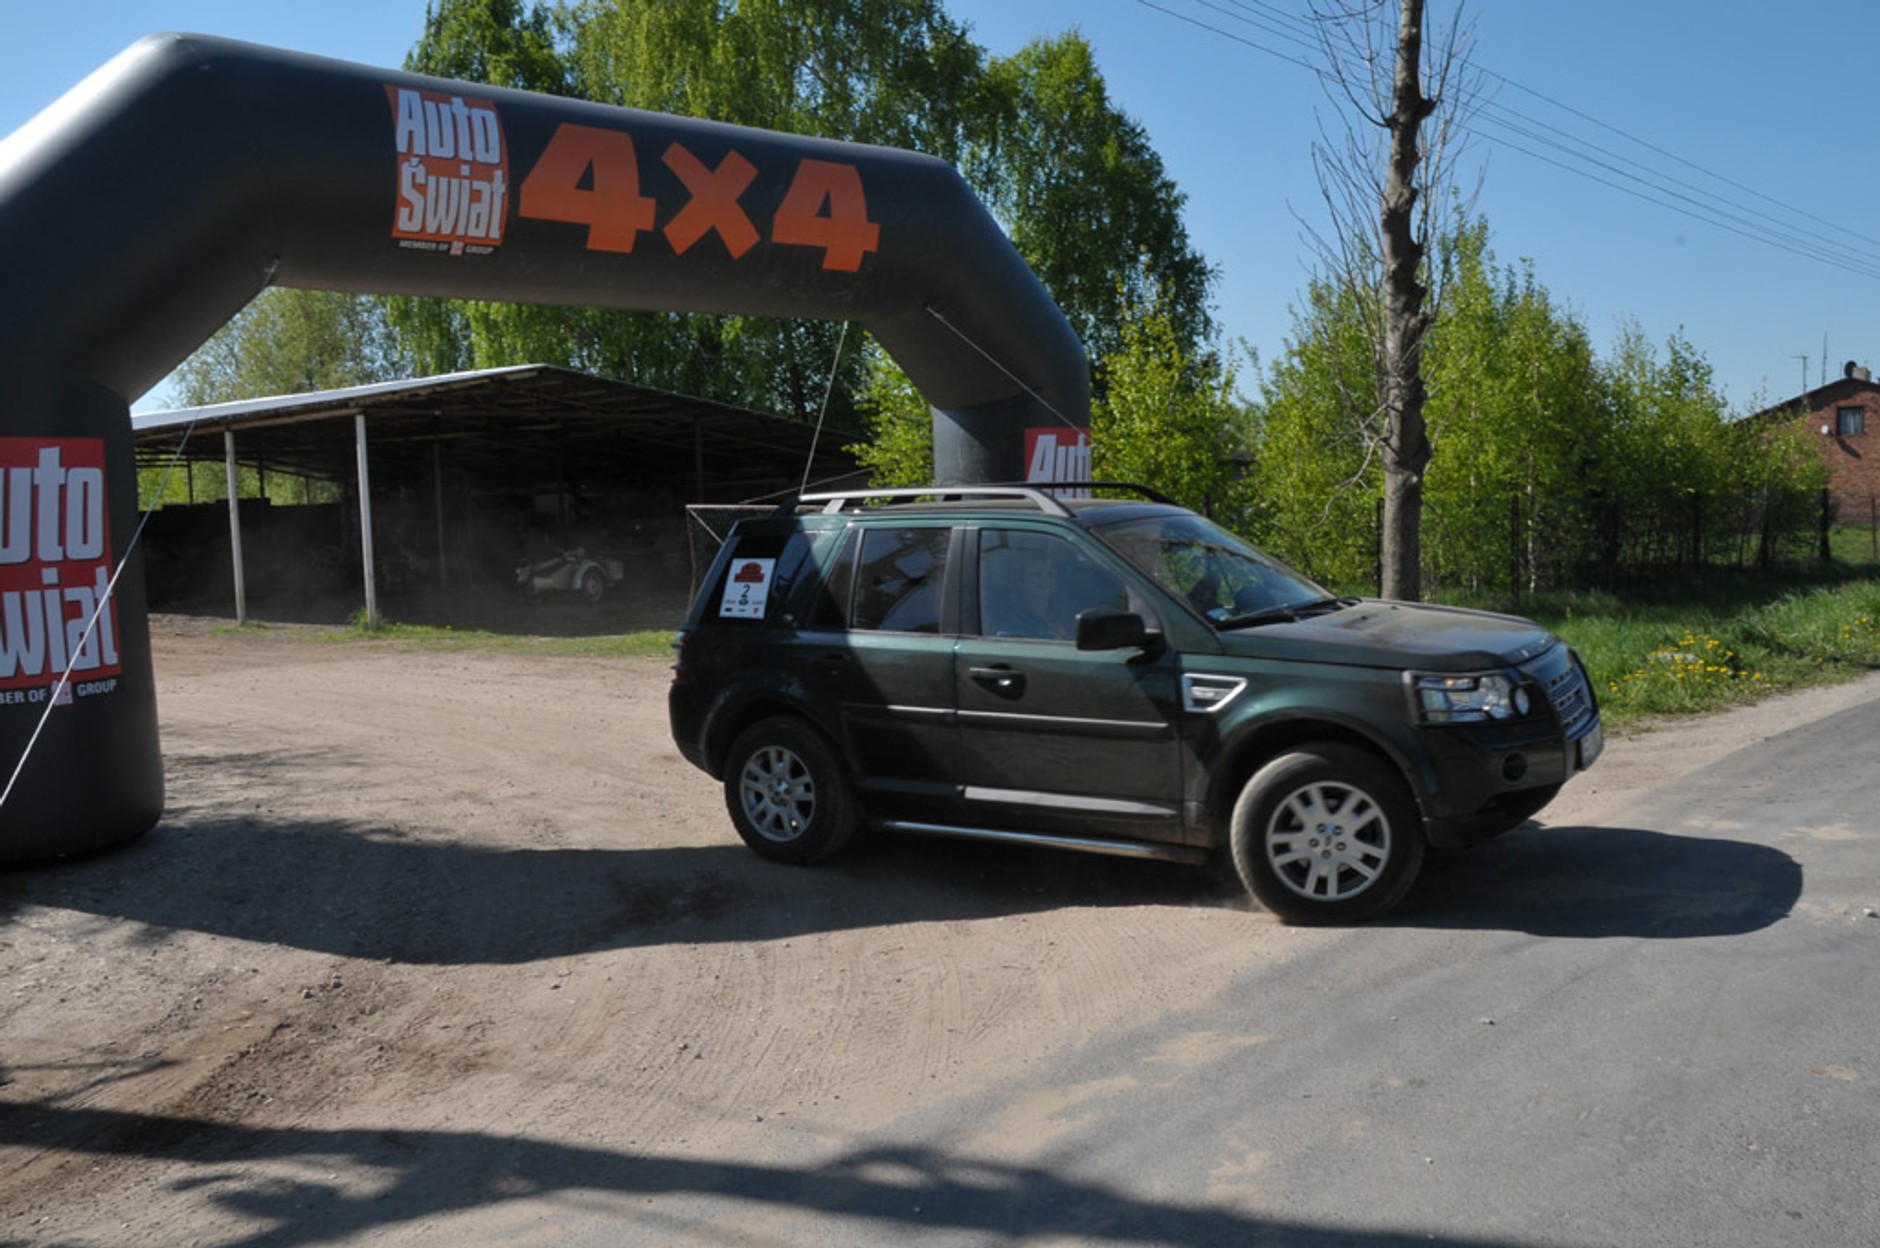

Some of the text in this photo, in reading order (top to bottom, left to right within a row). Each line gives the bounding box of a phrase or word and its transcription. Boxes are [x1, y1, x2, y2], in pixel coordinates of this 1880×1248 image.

[396, 88, 501, 165] Auto
[398, 156, 506, 240] Świat
[518, 122, 880, 272] 4x4
[0, 446, 104, 563] uto
[0, 565, 119, 678] wiat
[740, 584, 750, 598] 2
[28, 688, 48, 703] OF
[77, 679, 117, 696] GROUP
